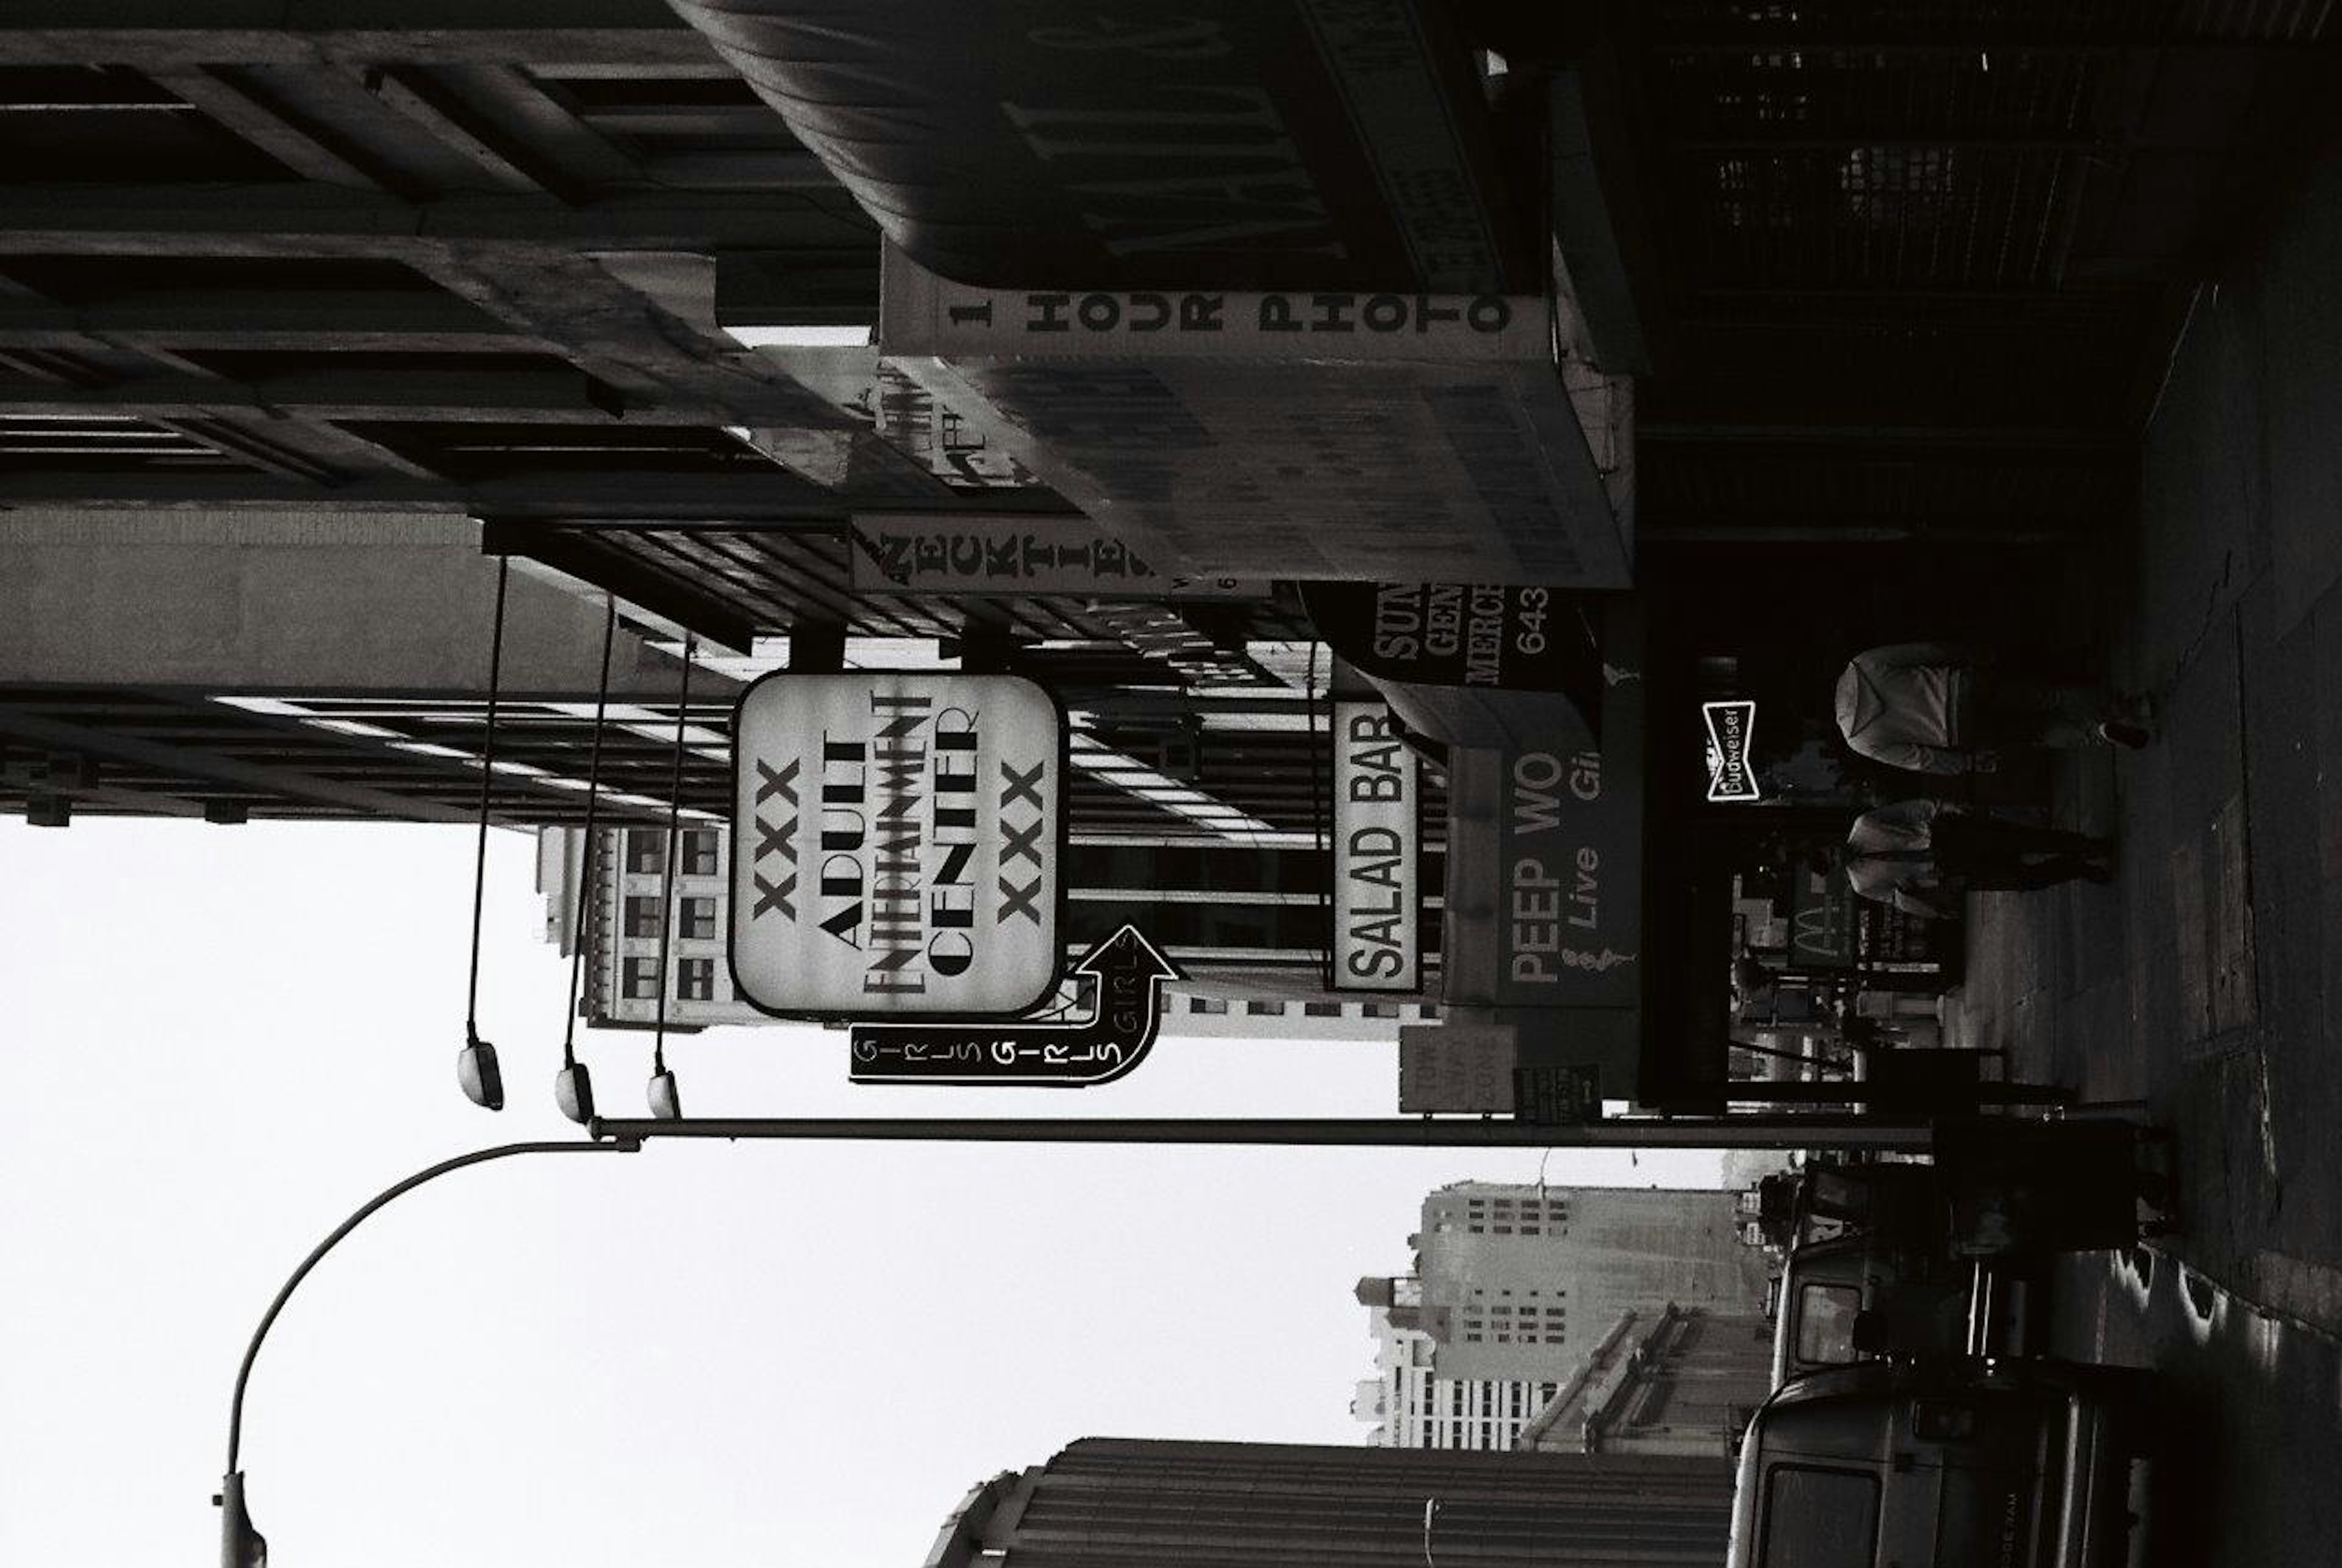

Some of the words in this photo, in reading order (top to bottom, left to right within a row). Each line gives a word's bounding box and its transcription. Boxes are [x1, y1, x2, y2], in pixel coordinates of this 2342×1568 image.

[1000, 85, 1349, 259] NAIL
[950, 301, 991, 326] 1
[1028, 295, 1222, 332] HOUR
[1260, 295, 1509, 332] PHOTO
[1516, 587, 1549, 654] 643
[1349, 714, 1402, 802] BAR
[1514, 752, 1562, 835] WO
[1719, 709, 1743, 793] Budweiser
[754, 758, 799, 922] XXX
[819, 730, 865, 950] ADULT
[864, 690, 931, 994] ENTERTAINMENT
[929, 707, 978, 976] CENTER
[998, 761, 1043, 926] XXX
[1568, 848, 1598, 929] Live
[1348, 827, 1402, 978] SALAD
[1512, 858, 1560, 982] PEEP
[1112, 933, 1141, 1034] GIRLS
[854, 1039, 982, 1063] GIRLS
[992, 1039, 1121, 1065] GIRLS
